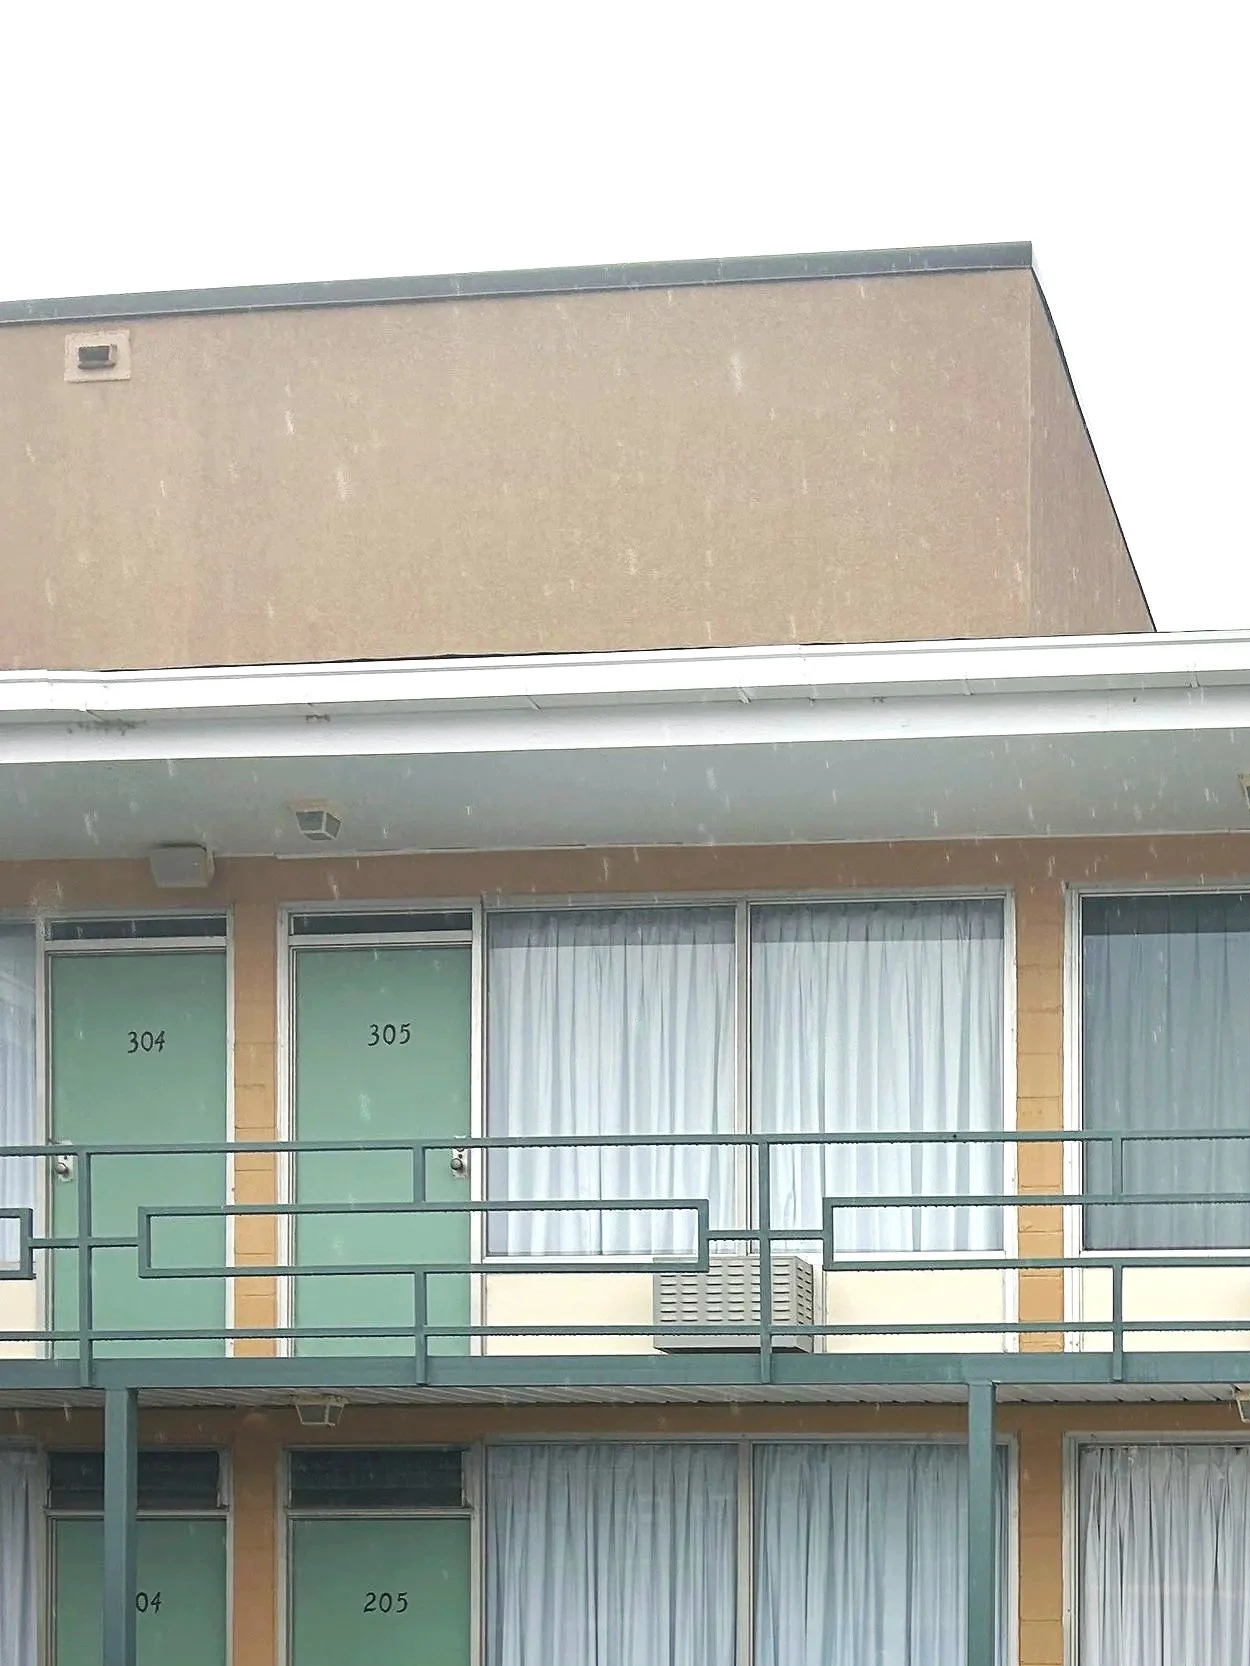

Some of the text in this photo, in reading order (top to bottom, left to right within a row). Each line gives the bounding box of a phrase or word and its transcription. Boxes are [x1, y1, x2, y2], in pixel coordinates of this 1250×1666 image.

[127, 1030, 166, 1054] 304
[368, 1023, 411, 1047] 305
[136, 1592, 162, 1613] 04
[363, 1592, 408, 1613] 205
